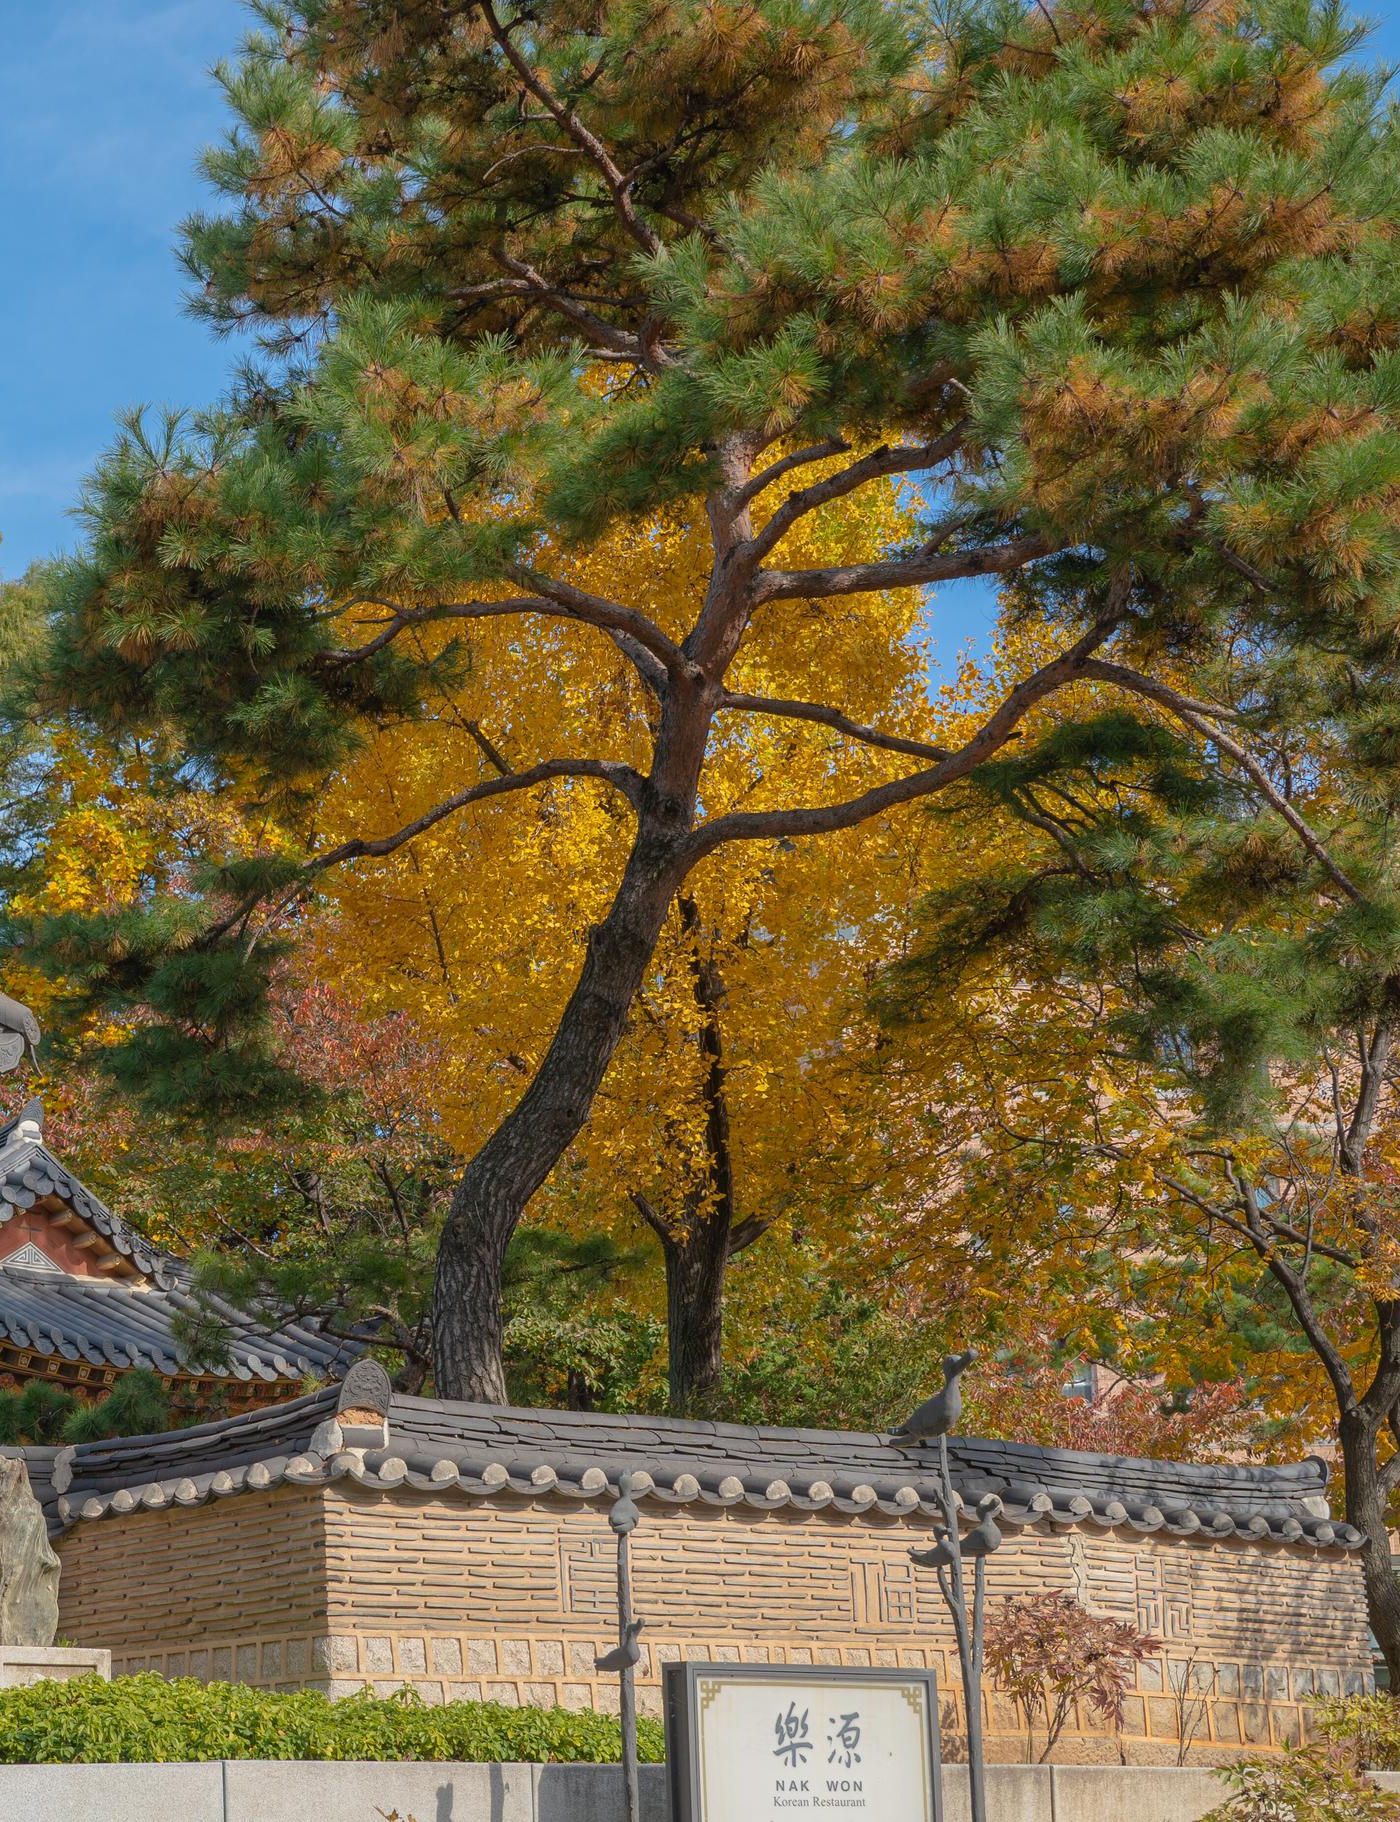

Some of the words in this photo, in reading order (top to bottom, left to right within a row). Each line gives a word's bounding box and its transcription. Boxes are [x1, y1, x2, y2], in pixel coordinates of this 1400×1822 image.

[775, 1780, 810, 1792] NAK
[825, 1780, 863, 1792] WON
[773, 1796, 810, 1807] Korean
[812, 1796, 866, 1807] Restaurant
